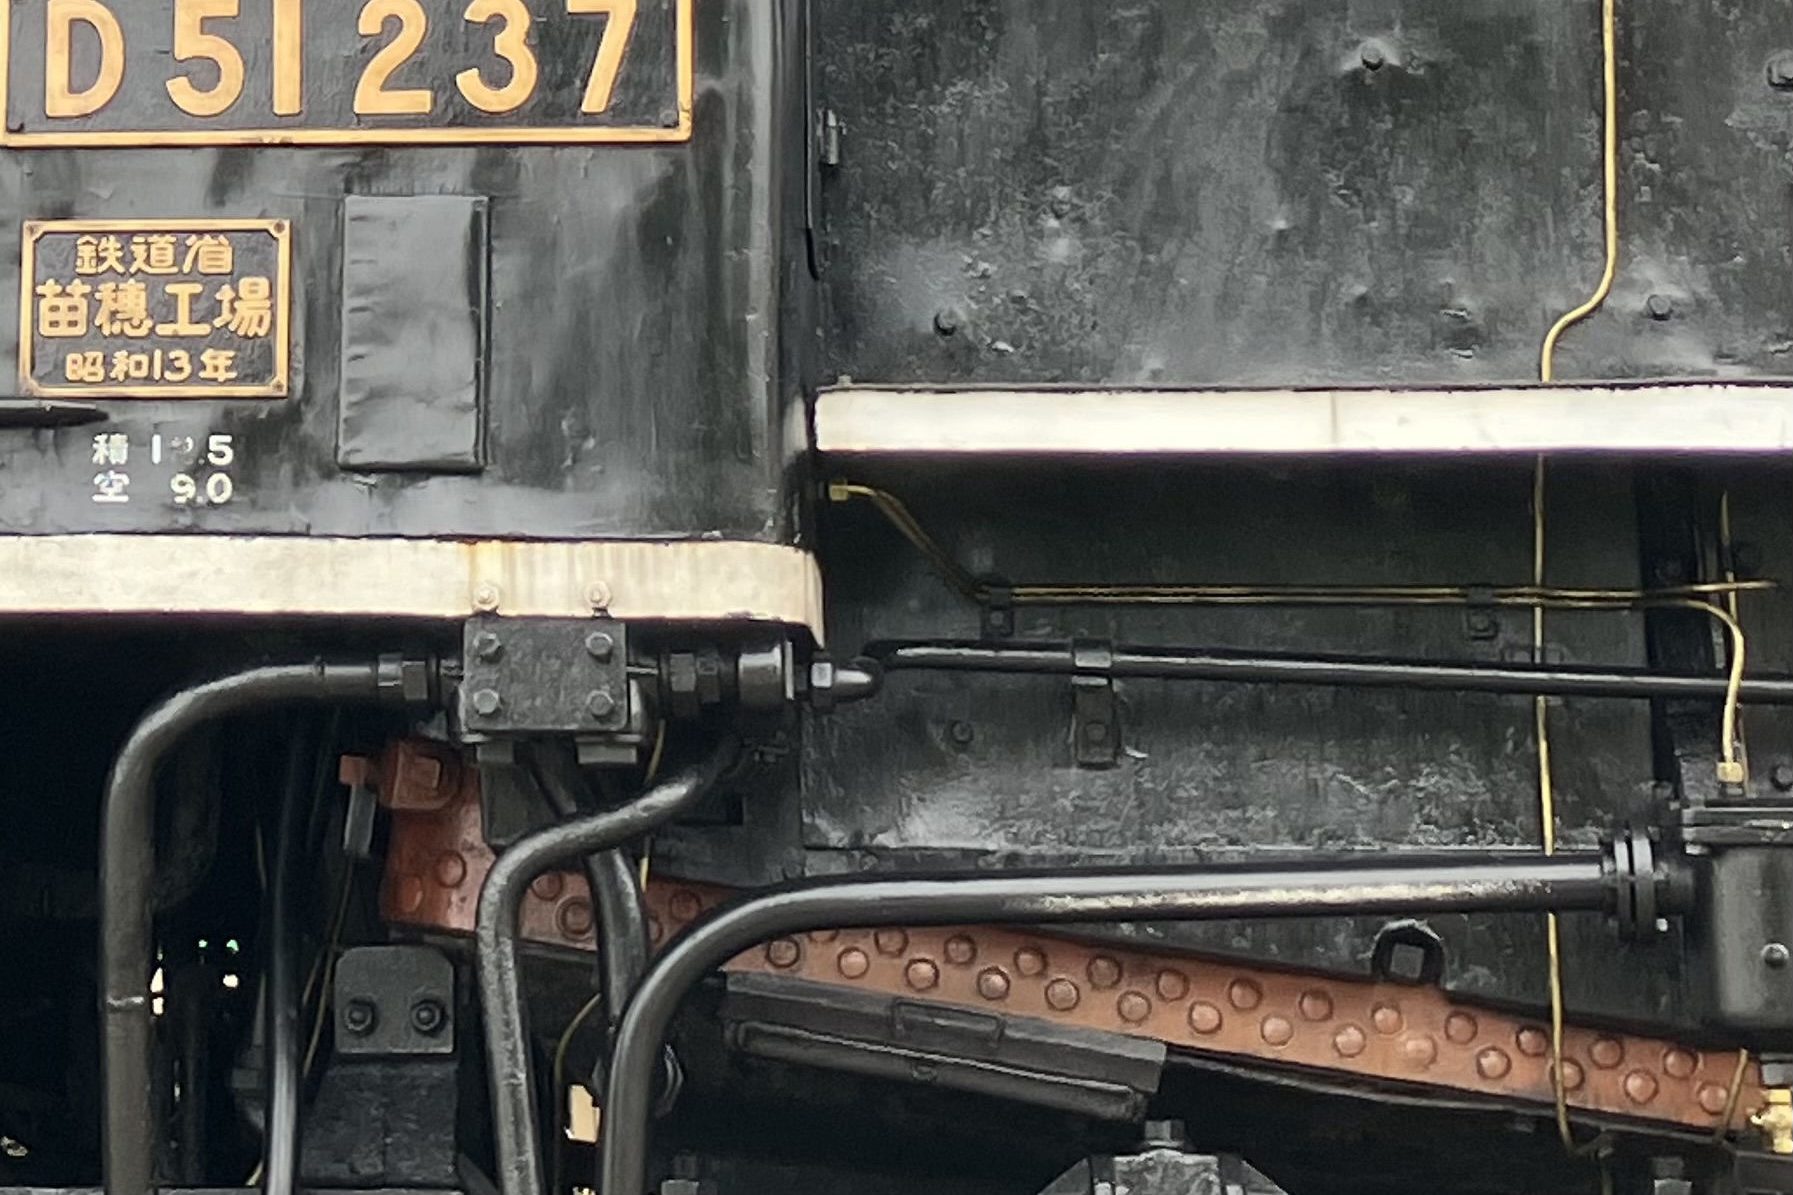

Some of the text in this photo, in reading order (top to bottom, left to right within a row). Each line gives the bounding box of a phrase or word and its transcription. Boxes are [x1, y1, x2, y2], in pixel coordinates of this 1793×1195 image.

[75, 234, 233, 275] 鉄道省
[65, 348, 238, 383] 昭和13年
[92, 433, 129, 466] 積
[91, 469, 130, 503] 空
